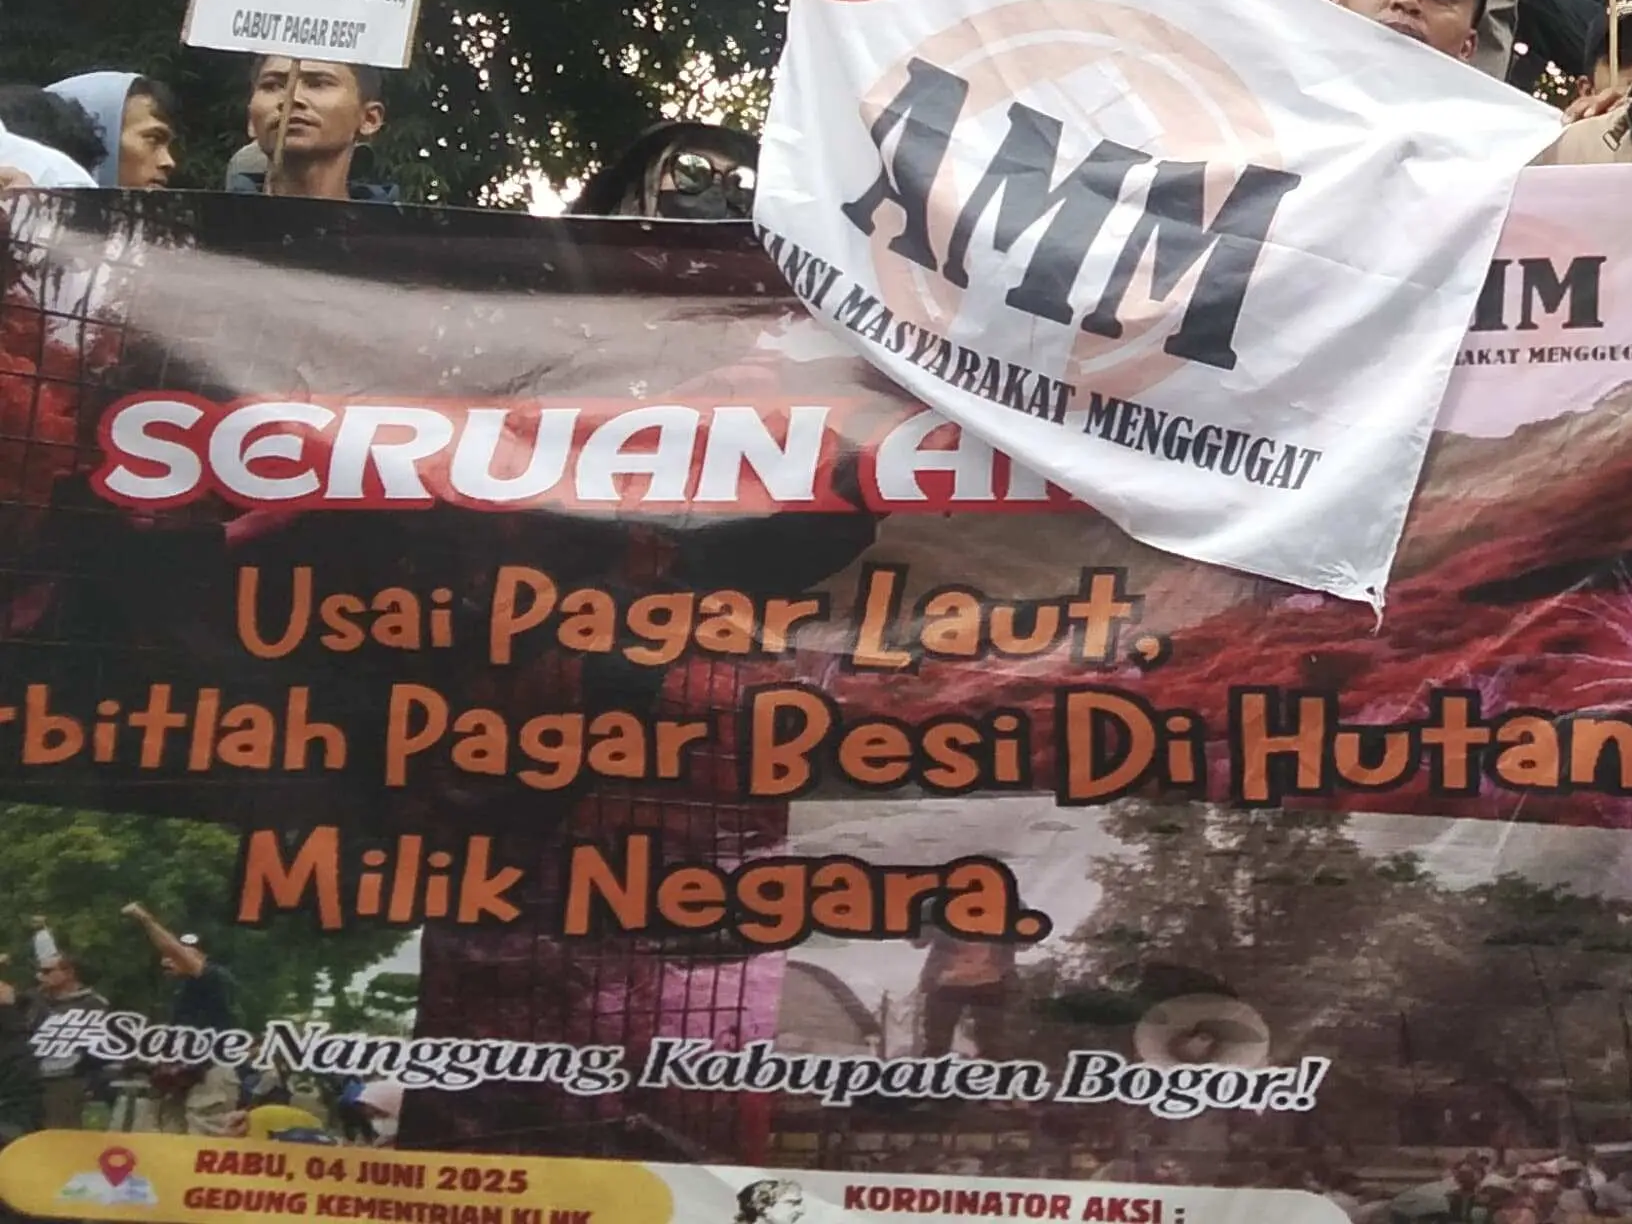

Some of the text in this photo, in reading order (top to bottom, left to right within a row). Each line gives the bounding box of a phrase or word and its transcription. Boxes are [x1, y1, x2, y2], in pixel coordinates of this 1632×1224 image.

[233, 10, 282, 41] CABUT
[282, 15, 329, 46] PAGAR
[842, 57, 1300, 370] AMM
[834, 283, 1077, 425] MASYARAKAT
[1083, 391, 1322, 491] MENGGUGAT
[103, 400, 832, 502] SERUAN
[238, 566, 452, 658] Usai
[490, 566, 819, 666] Pagar
[386, 684, 707, 789] Pagar
[751, 690, 1019, 795] Besi
[1067, 690, 1194, 799] Di
[238, 825, 1041, 944] Milik Negara.
[29, 1007, 250, 1066] #Save
[251, 1018, 628, 1097] Nanggung,
[638, 1037, 1052, 1106] Kabupaten
[183, 1186, 307, 1214] GEDUNG
[315, 1192, 500, 1224] KEMENTRIAN
[194, 1149, 528, 1194] RABU, 04 JUNI 2025
[844, 1185, 1071, 1221] KORDINATOR
[1081, 1196, 1162, 1224] AKSI
